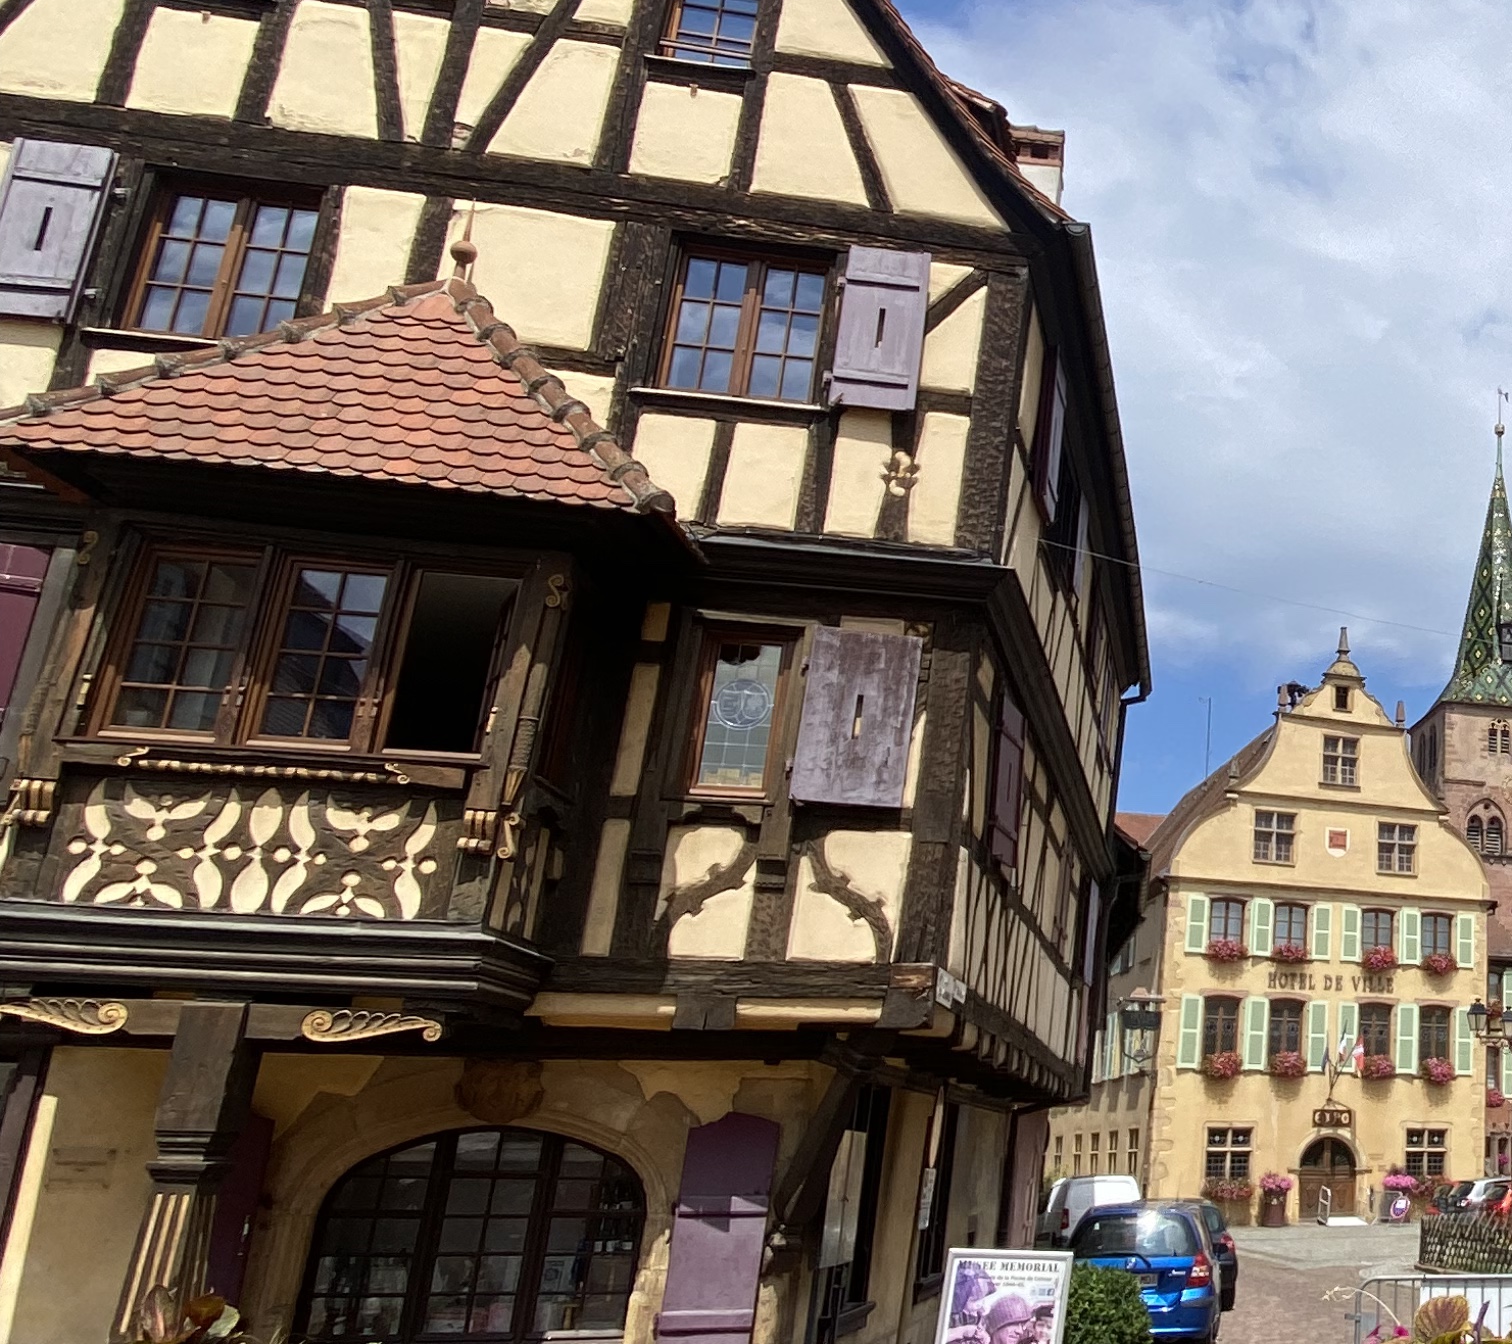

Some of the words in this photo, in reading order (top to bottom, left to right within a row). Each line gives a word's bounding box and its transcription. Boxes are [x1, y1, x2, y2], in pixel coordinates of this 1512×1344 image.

[1267, 972, 1316, 990] HOTEL
[1323, 973, 1343, 991] DE
[1351, 975, 1395, 994] VILLE
[1000, 1262, 1060, 1272] MEMORIAL
